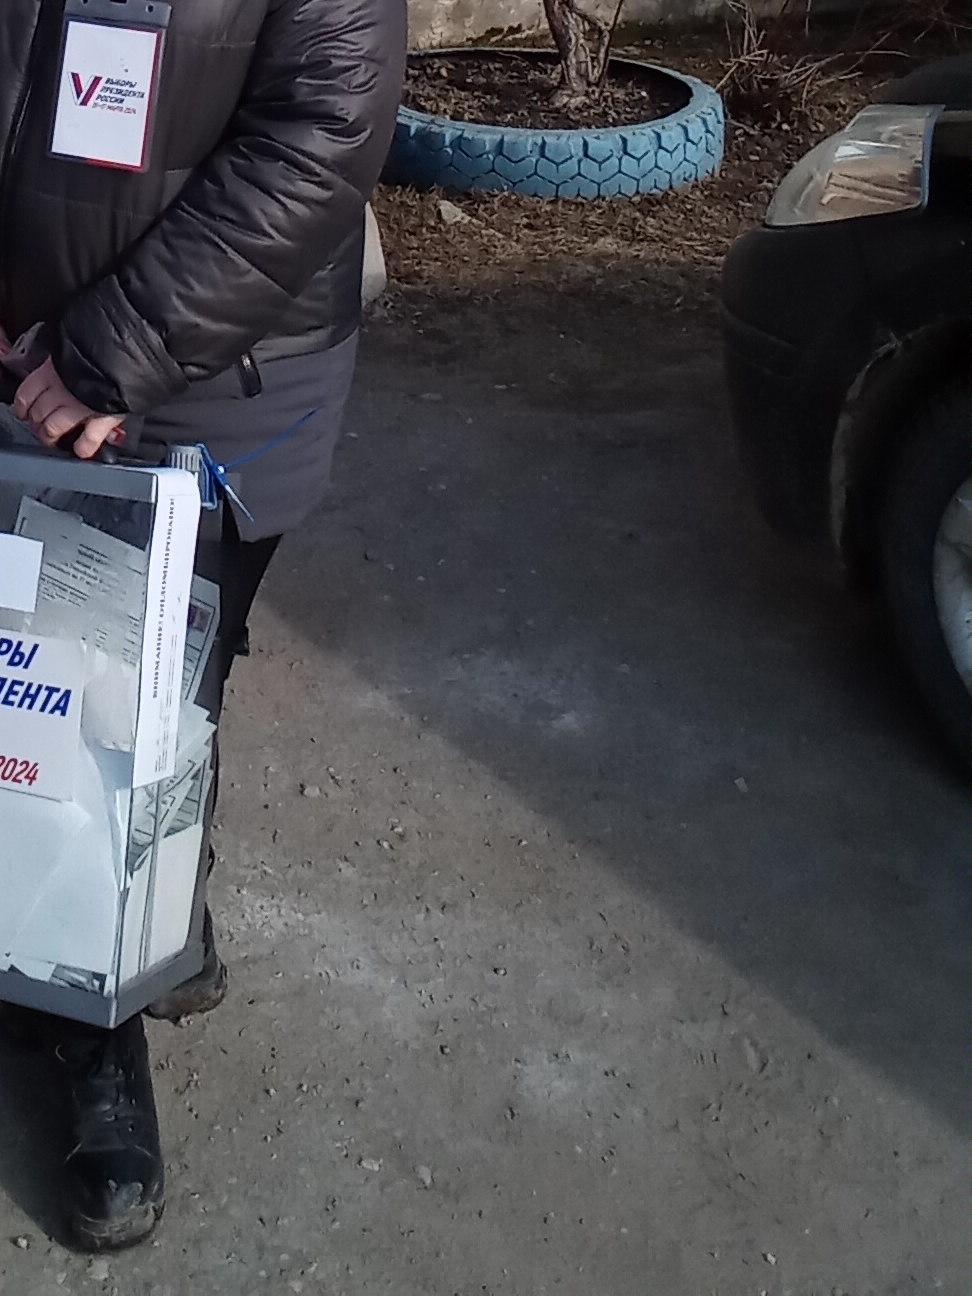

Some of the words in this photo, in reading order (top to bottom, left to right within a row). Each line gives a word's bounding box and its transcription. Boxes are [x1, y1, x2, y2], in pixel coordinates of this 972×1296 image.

[105, 77, 137, 88] ВЫБОРЫ
[100, 86, 145, 99] ПРЕЗИДЕНТА
[95, 94, 125, 104] РОССИИ
